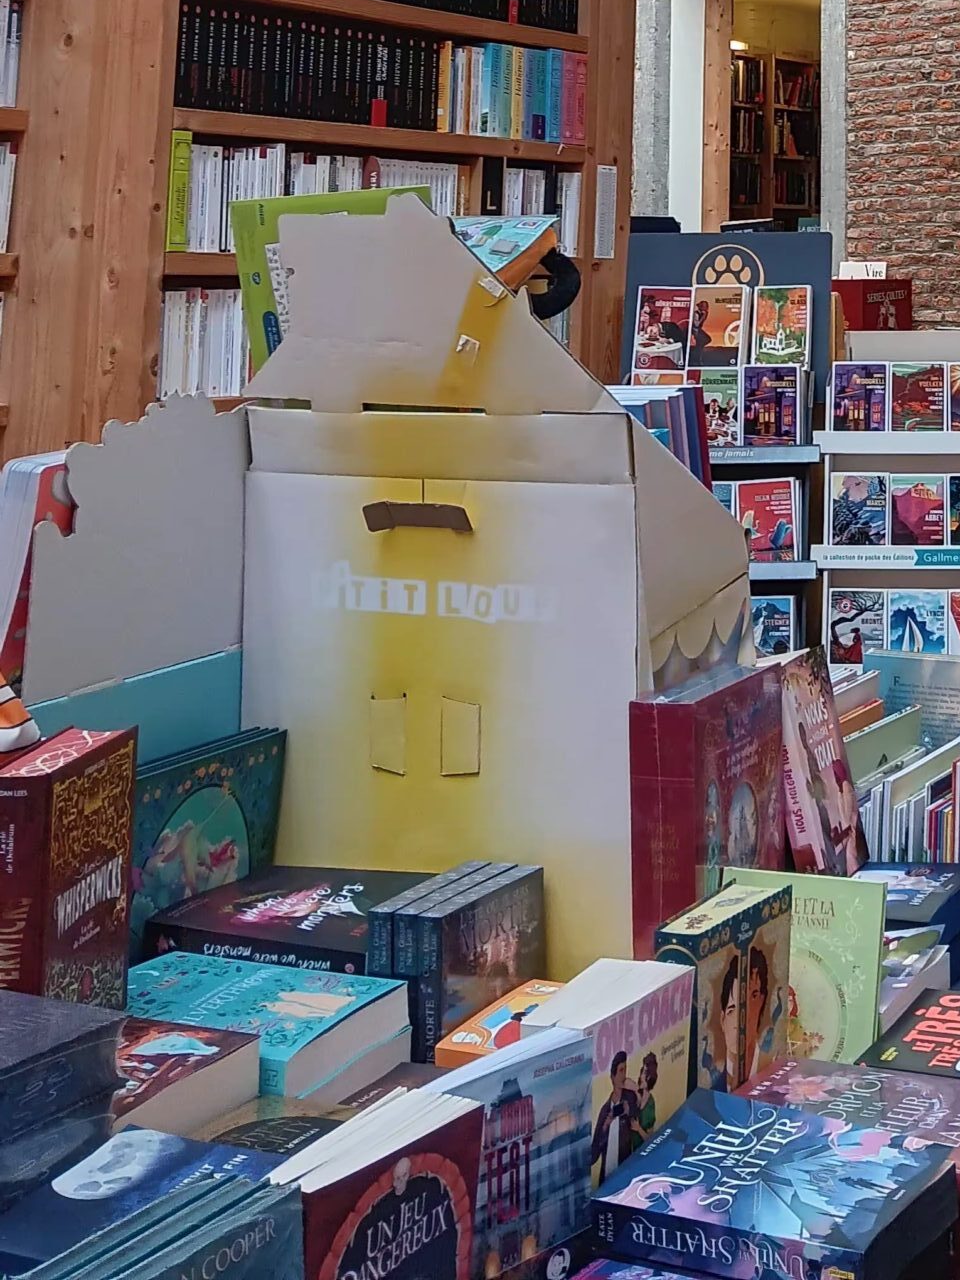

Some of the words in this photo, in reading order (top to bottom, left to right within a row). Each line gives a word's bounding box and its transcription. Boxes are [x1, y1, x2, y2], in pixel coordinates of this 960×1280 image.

[804, 696, 829, 728] NOUS
[813, 737, 837, 771] TOUT
[55, 855, 123, 939] WHISPERWICKS
[239, 895, 281, 922] when
[273, 896, 298, 915] we
[298, 886, 332, 910] were
[296, 882, 365, 932] monsters
[820, 900, 836, 917] LA
[203, 942, 252, 958] monsters
[640, 973, 694, 1049] COACH
[912, 1040, 936, 1052] LE
[874, 1096, 932, 1132] FLEUR
[640, 1142, 656, 1156] KATE
[653, 1128, 673, 1147] DYLAN
[660, 1107, 779, 1188] UNTIL
[223, 1154, 250, 1171] FIN
[697, 1116, 806, 1213] SHATTER
[720, 1152, 744, 1168] WE
[366, 1218, 394, 1257] UN
[395, 1192, 427, 1233] JEU
[606, 1212, 614, 1243] DYLAN
[631, 1215, 736, 1265] SHATTER
[201, 1218, 277, 1278] COOPER
